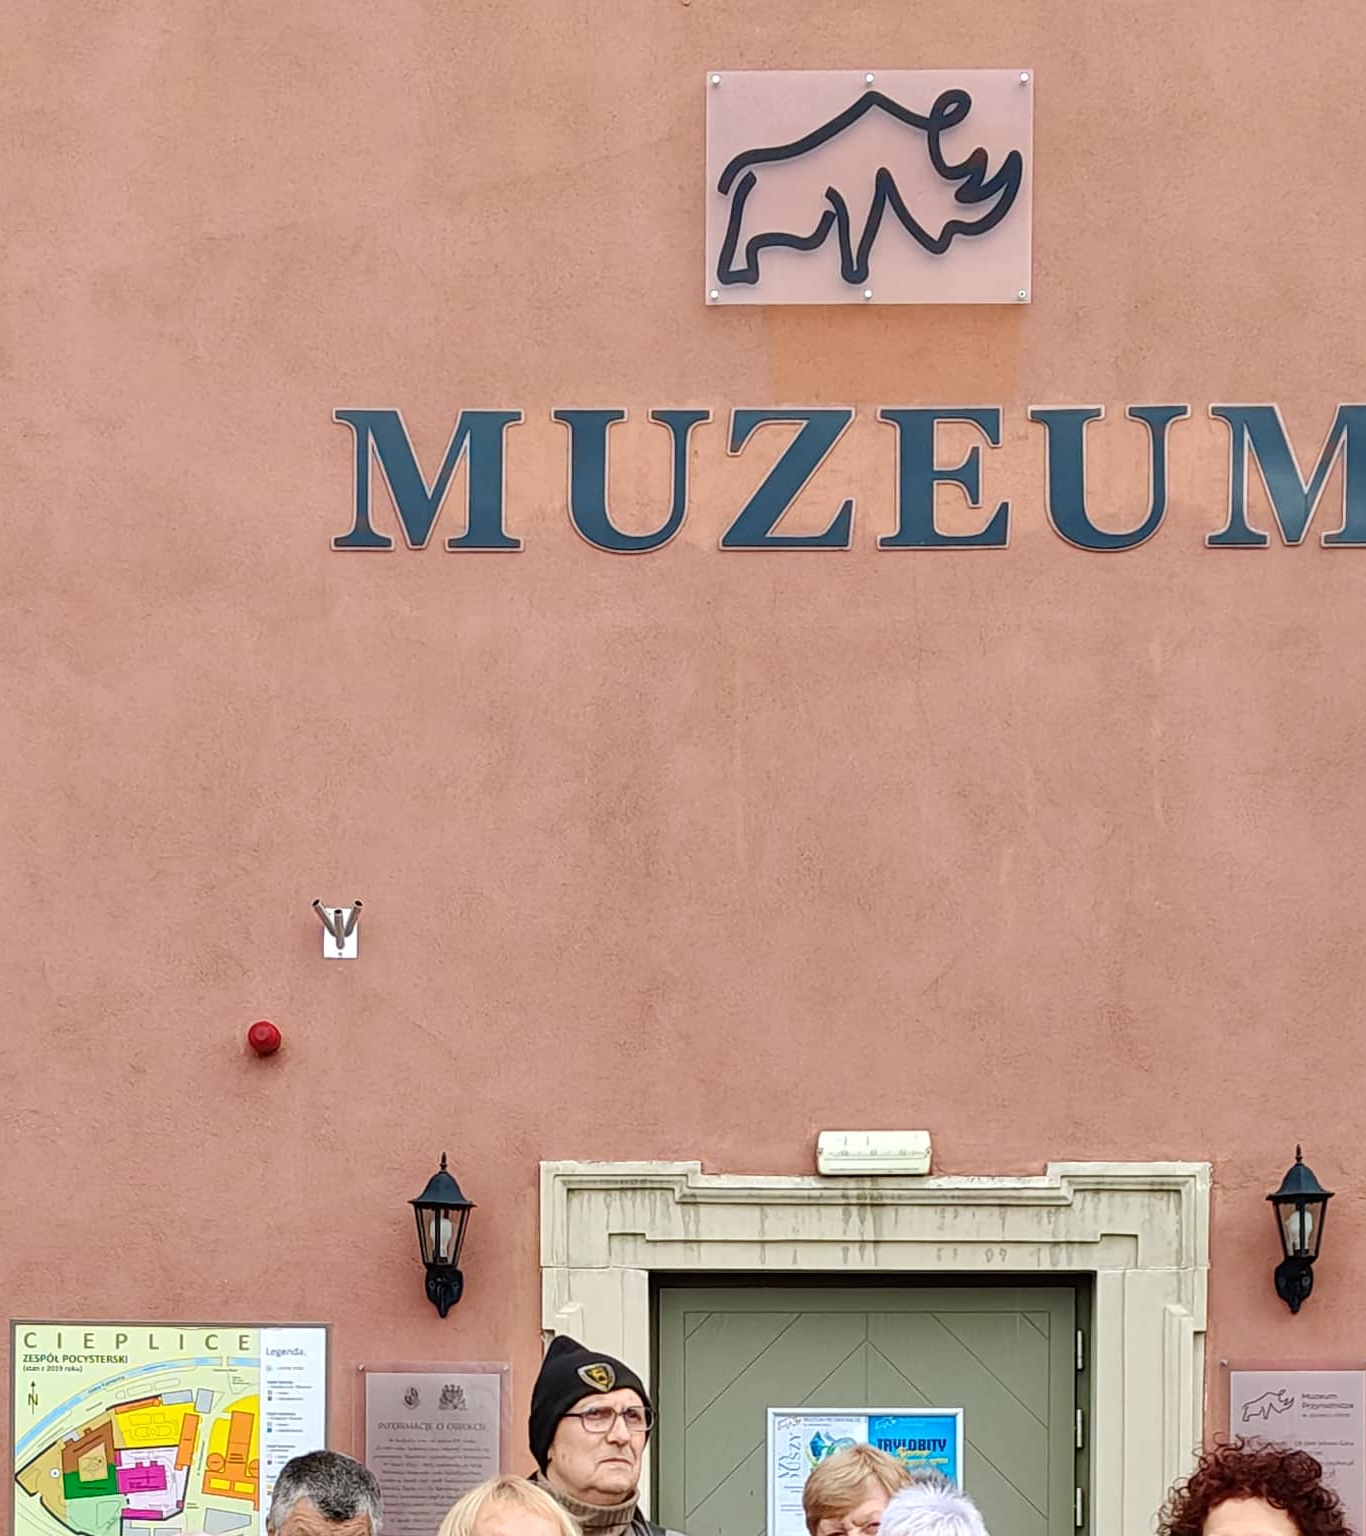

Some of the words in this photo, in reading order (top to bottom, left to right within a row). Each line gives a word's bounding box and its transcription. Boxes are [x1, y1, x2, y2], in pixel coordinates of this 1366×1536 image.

[22, 1331, 251, 1352] CIEPLICE
[22, 1353, 60, 1364] ZESPÓŁ
[62, 1354, 129, 1365] POCYSTERSKI
